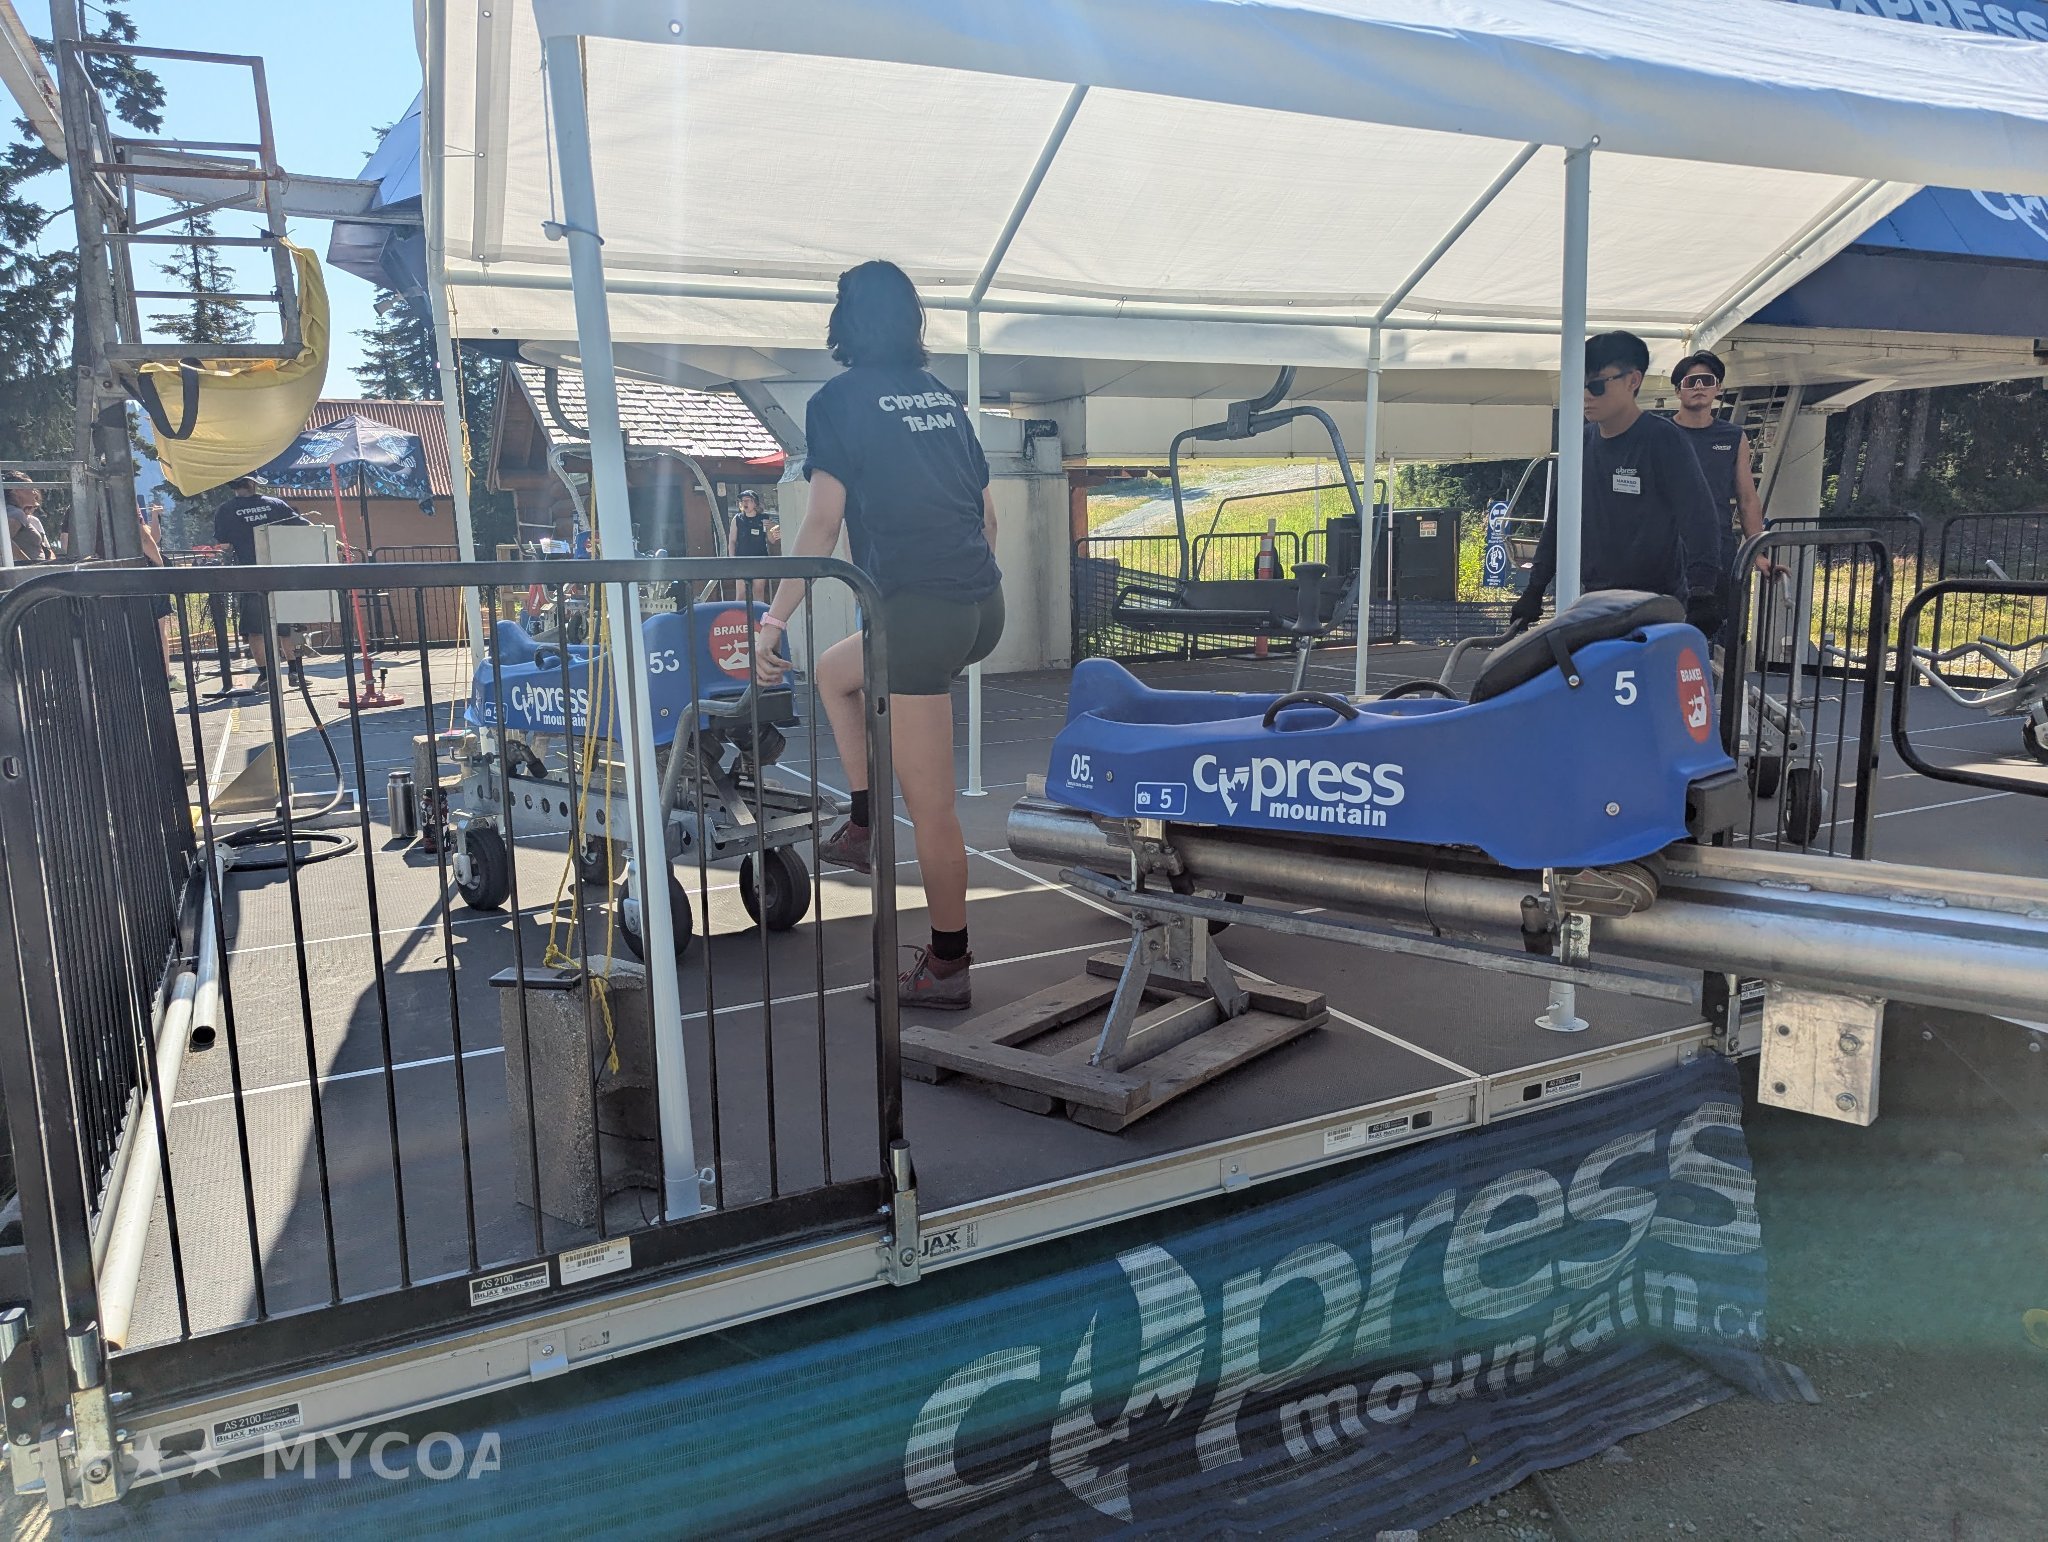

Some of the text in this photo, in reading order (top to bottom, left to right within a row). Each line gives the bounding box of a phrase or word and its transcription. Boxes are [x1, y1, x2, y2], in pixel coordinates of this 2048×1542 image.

[878, 391, 957, 412] CYPRESS
[902, 412, 957, 433] TEAM
[236, 505, 272, 516] CYPRESS
[244, 513, 268, 523] TEAM
[1614, 670, 1638, 706] 5
[543, 713, 587, 727] mouain
[1159, 788, 1172, 809] 5
[1268, 801, 1387, 827] mountain
[919, 1231, 958, 1257] JAX
[481, 1279, 493, 1290] AS
[494, 1274, 514, 1287] 2100
[223, 1420, 240, 1432] AS
[240, 1414, 261, 1428] 2100
